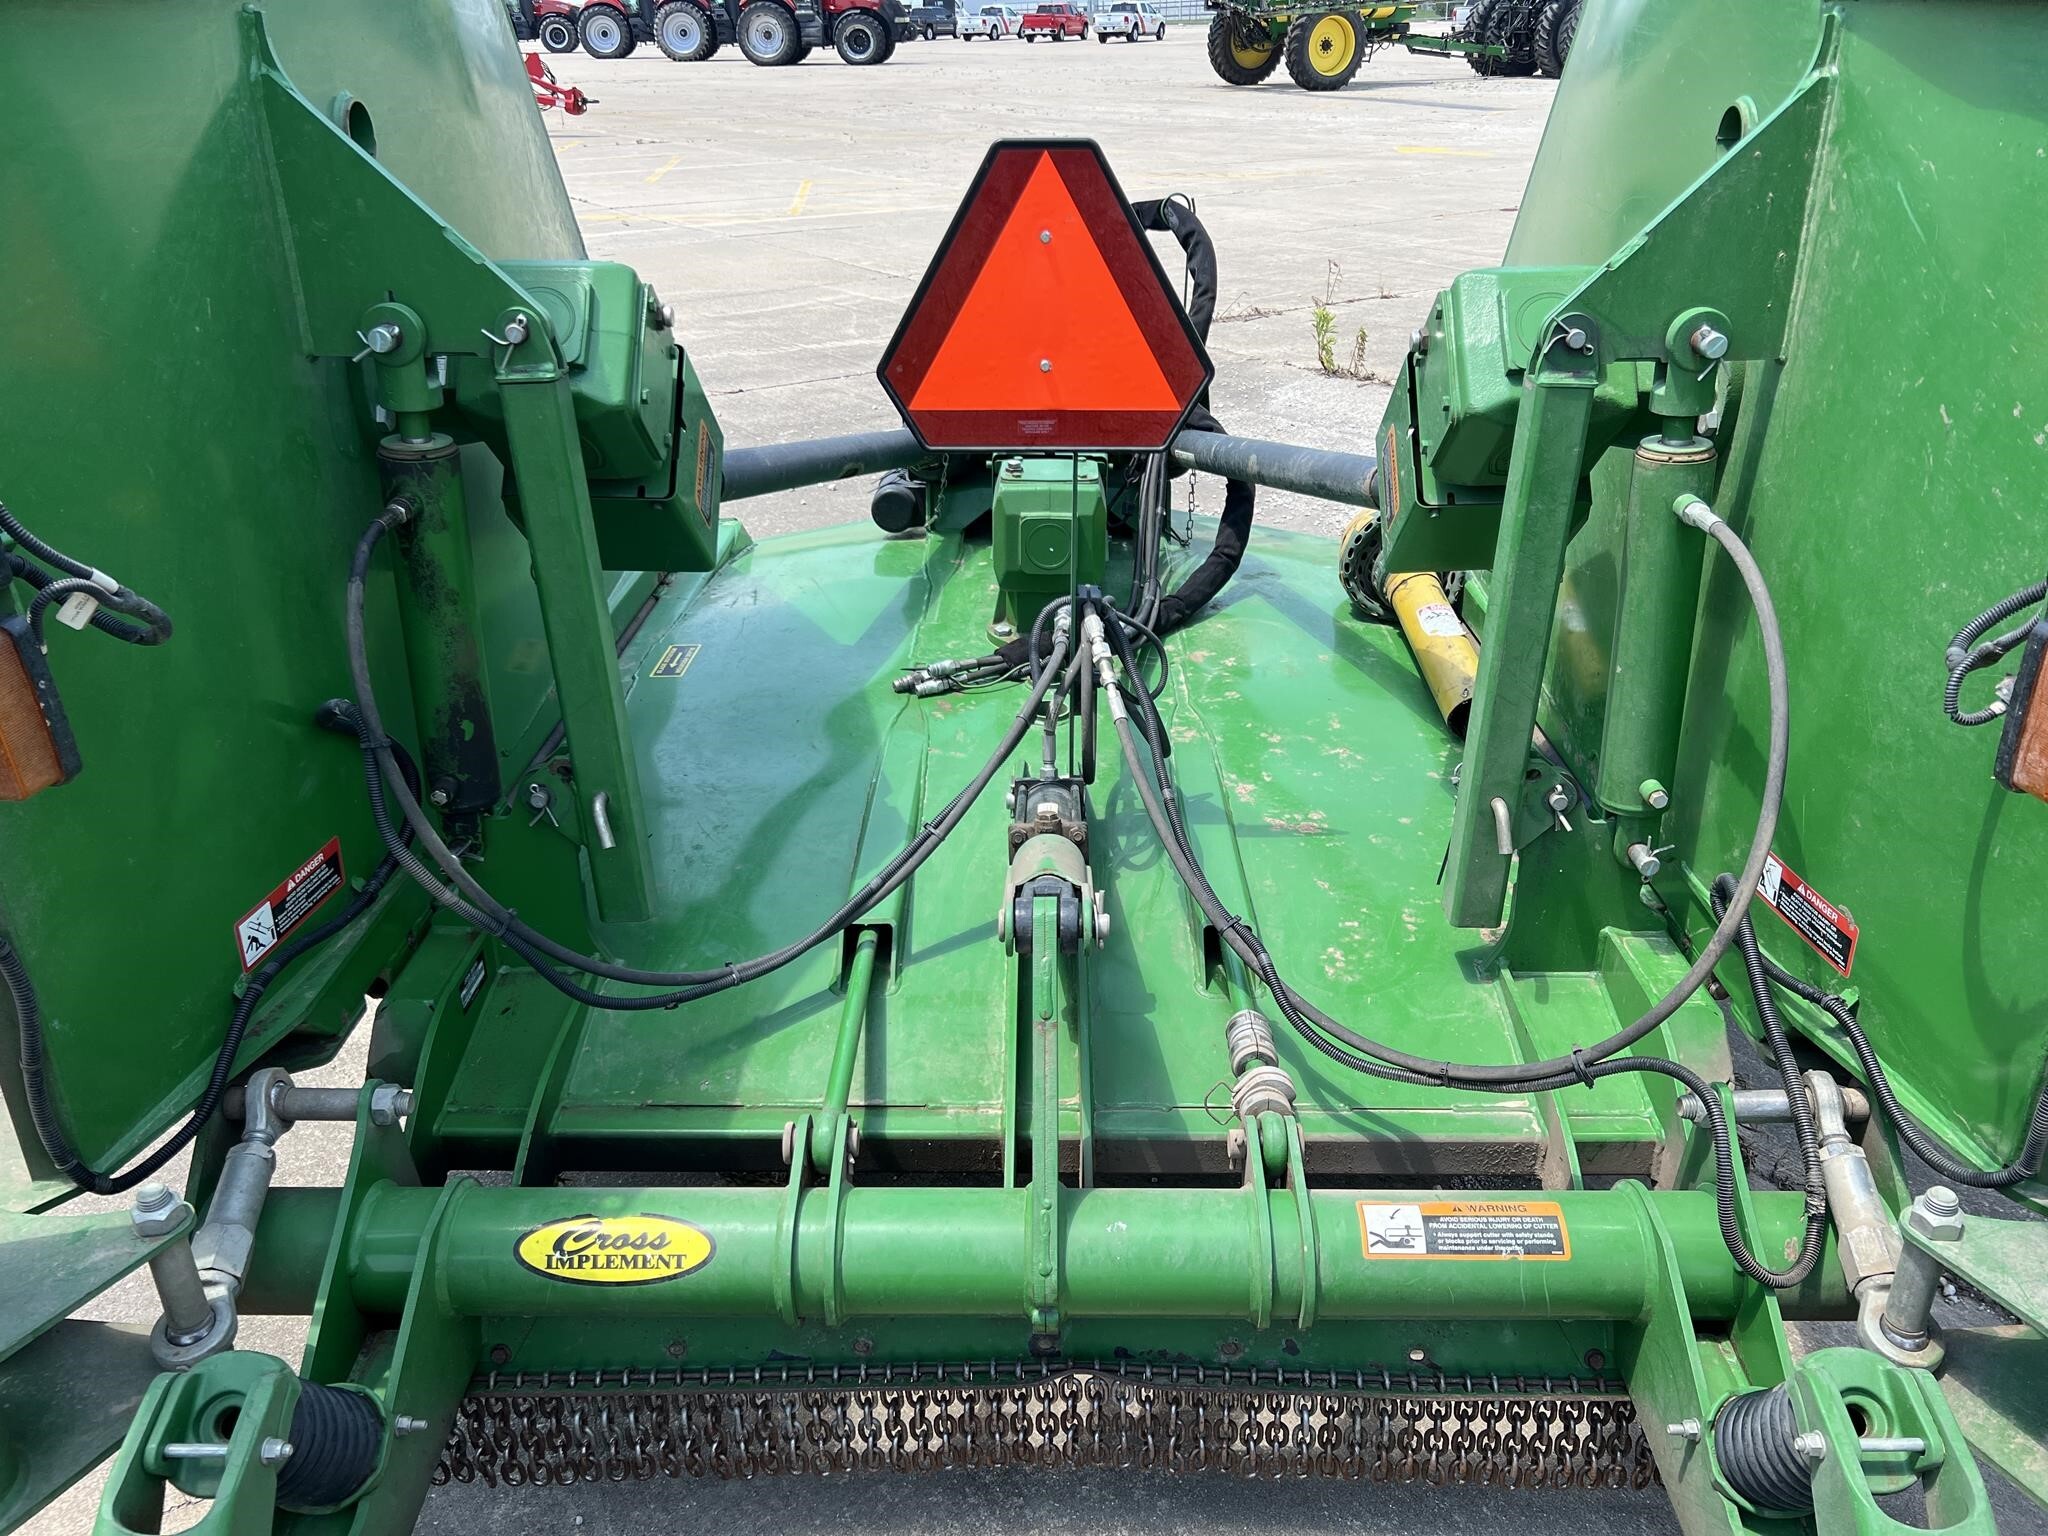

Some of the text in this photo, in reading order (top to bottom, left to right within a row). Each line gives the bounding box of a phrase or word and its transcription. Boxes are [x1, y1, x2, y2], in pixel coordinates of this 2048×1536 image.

[295, 853, 324, 883] DANGER
[1806, 892, 1838, 923] DANGER
[1467, 1204, 1528, 1212] WARNING
[553, 1221, 671, 1258] Cross
[545, 1254, 687, 1270] IMPLEMENT
